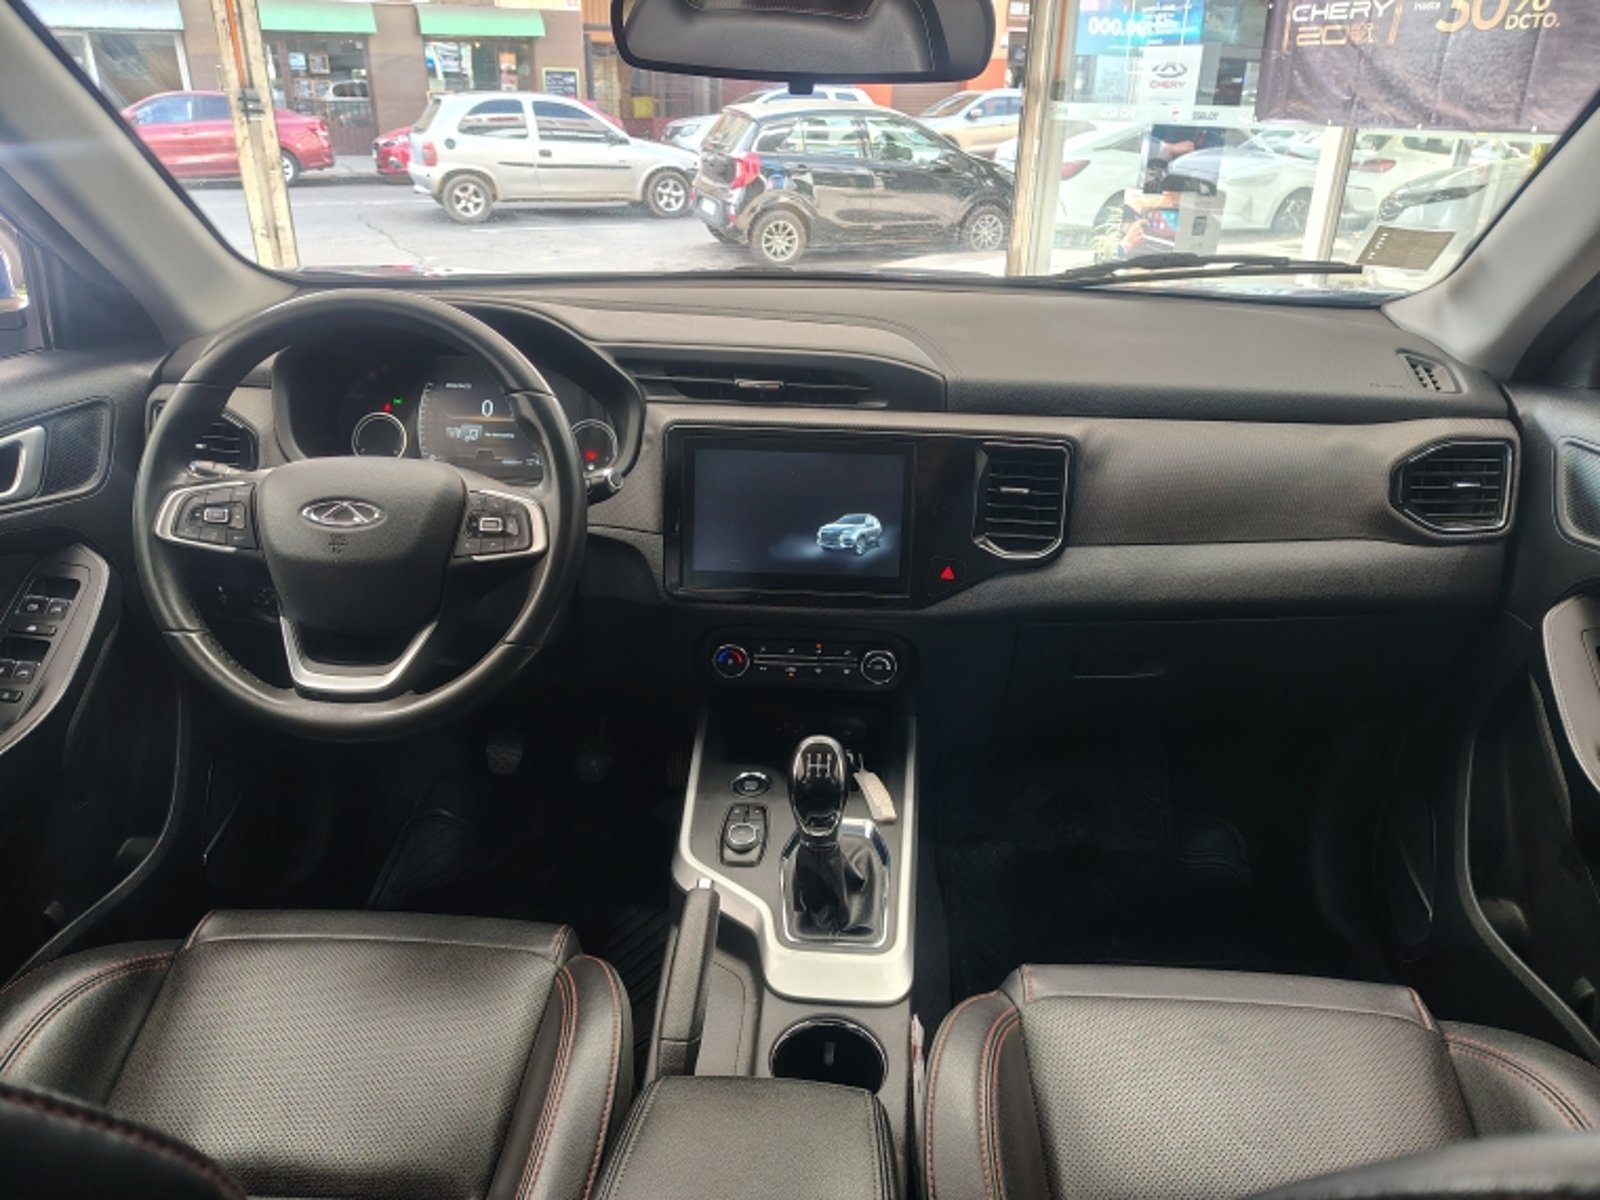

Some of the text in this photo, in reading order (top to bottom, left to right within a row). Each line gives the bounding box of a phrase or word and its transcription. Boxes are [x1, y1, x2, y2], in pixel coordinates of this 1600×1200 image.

[1292, 1, 1394, 22] CHERY
[1504, 12, 1561, 30] DCTO.
[1149, 79, 1186, 89] CHERY
[481, 399, 494, 417] 0
